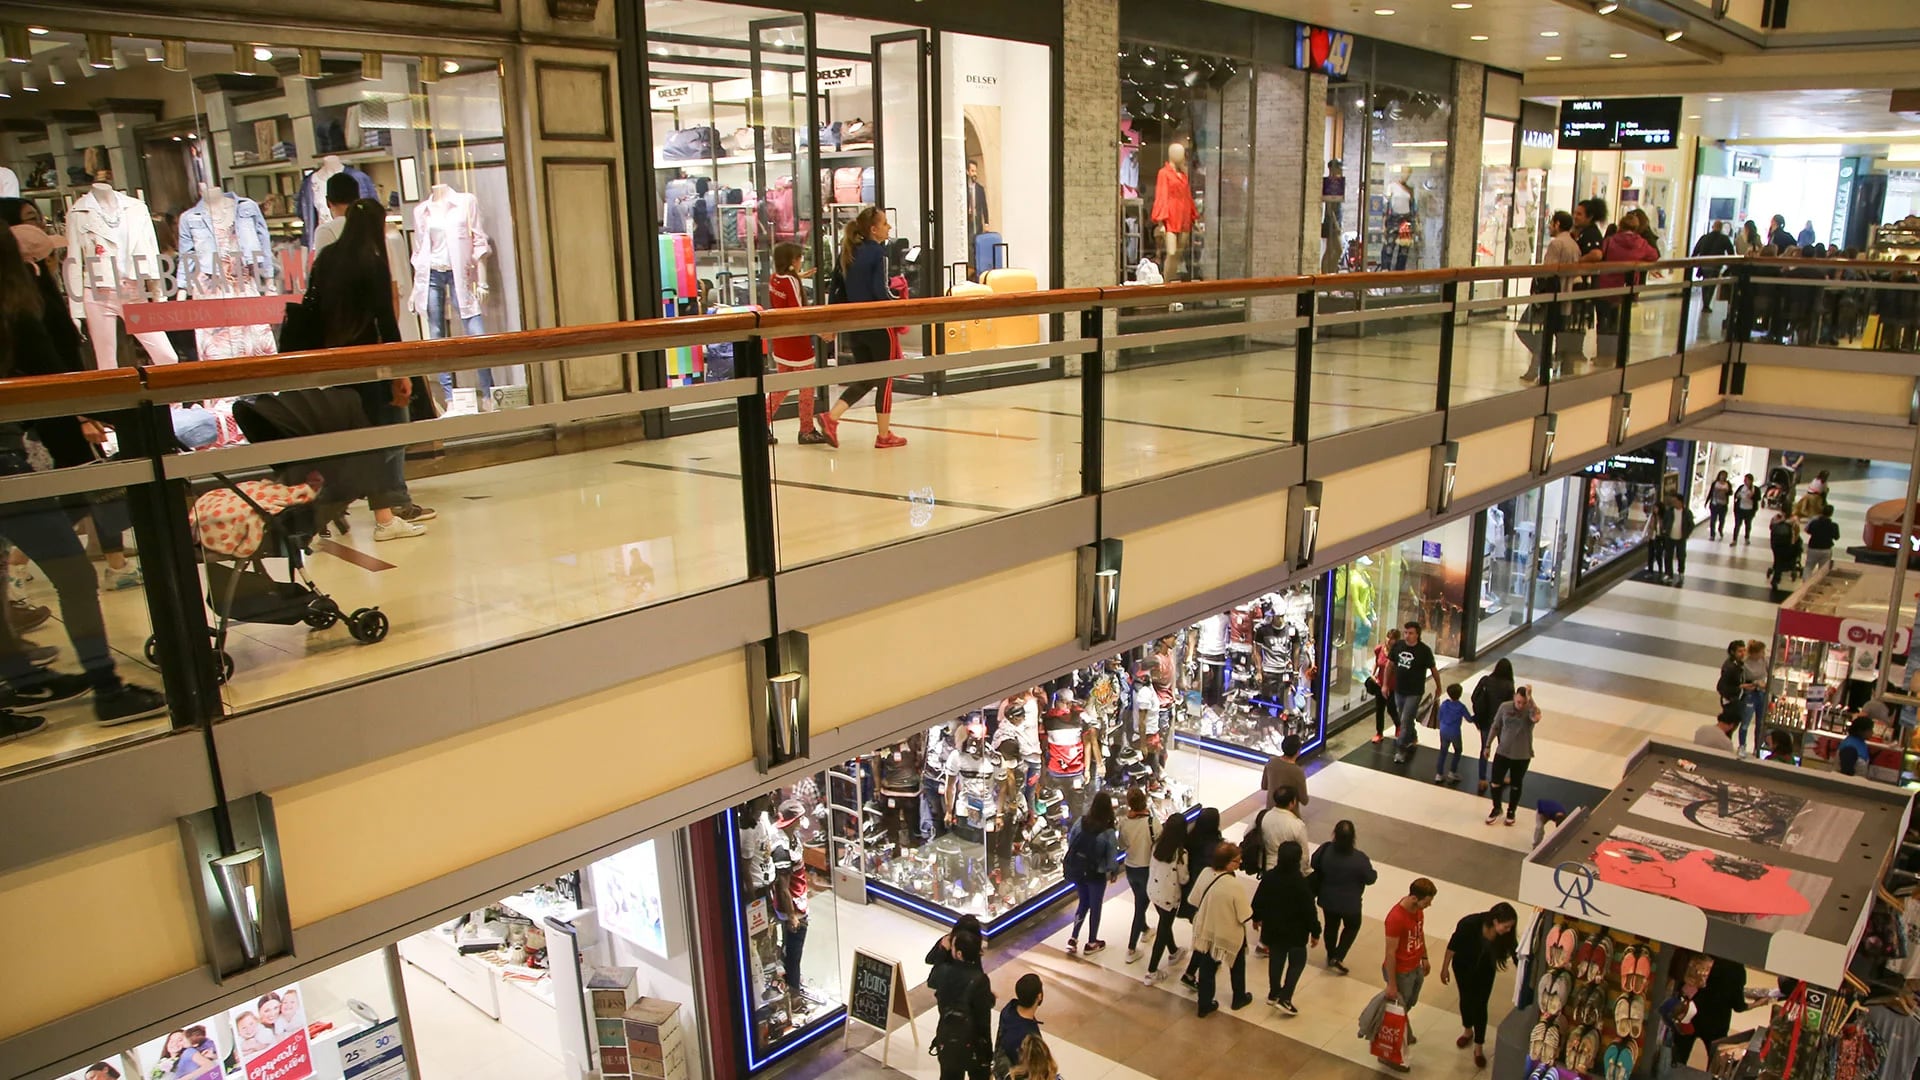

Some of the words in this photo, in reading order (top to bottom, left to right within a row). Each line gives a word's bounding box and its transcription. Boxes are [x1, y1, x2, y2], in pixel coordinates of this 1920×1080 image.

[966, 75, 998, 85] DELSEY
[658, 87, 689, 98] DELSEY
[1523, 129, 1553, 148] LAZARO
[62, 251, 271, 302] CELEBRATE
[1847, 625, 1900, 649] Oin!
